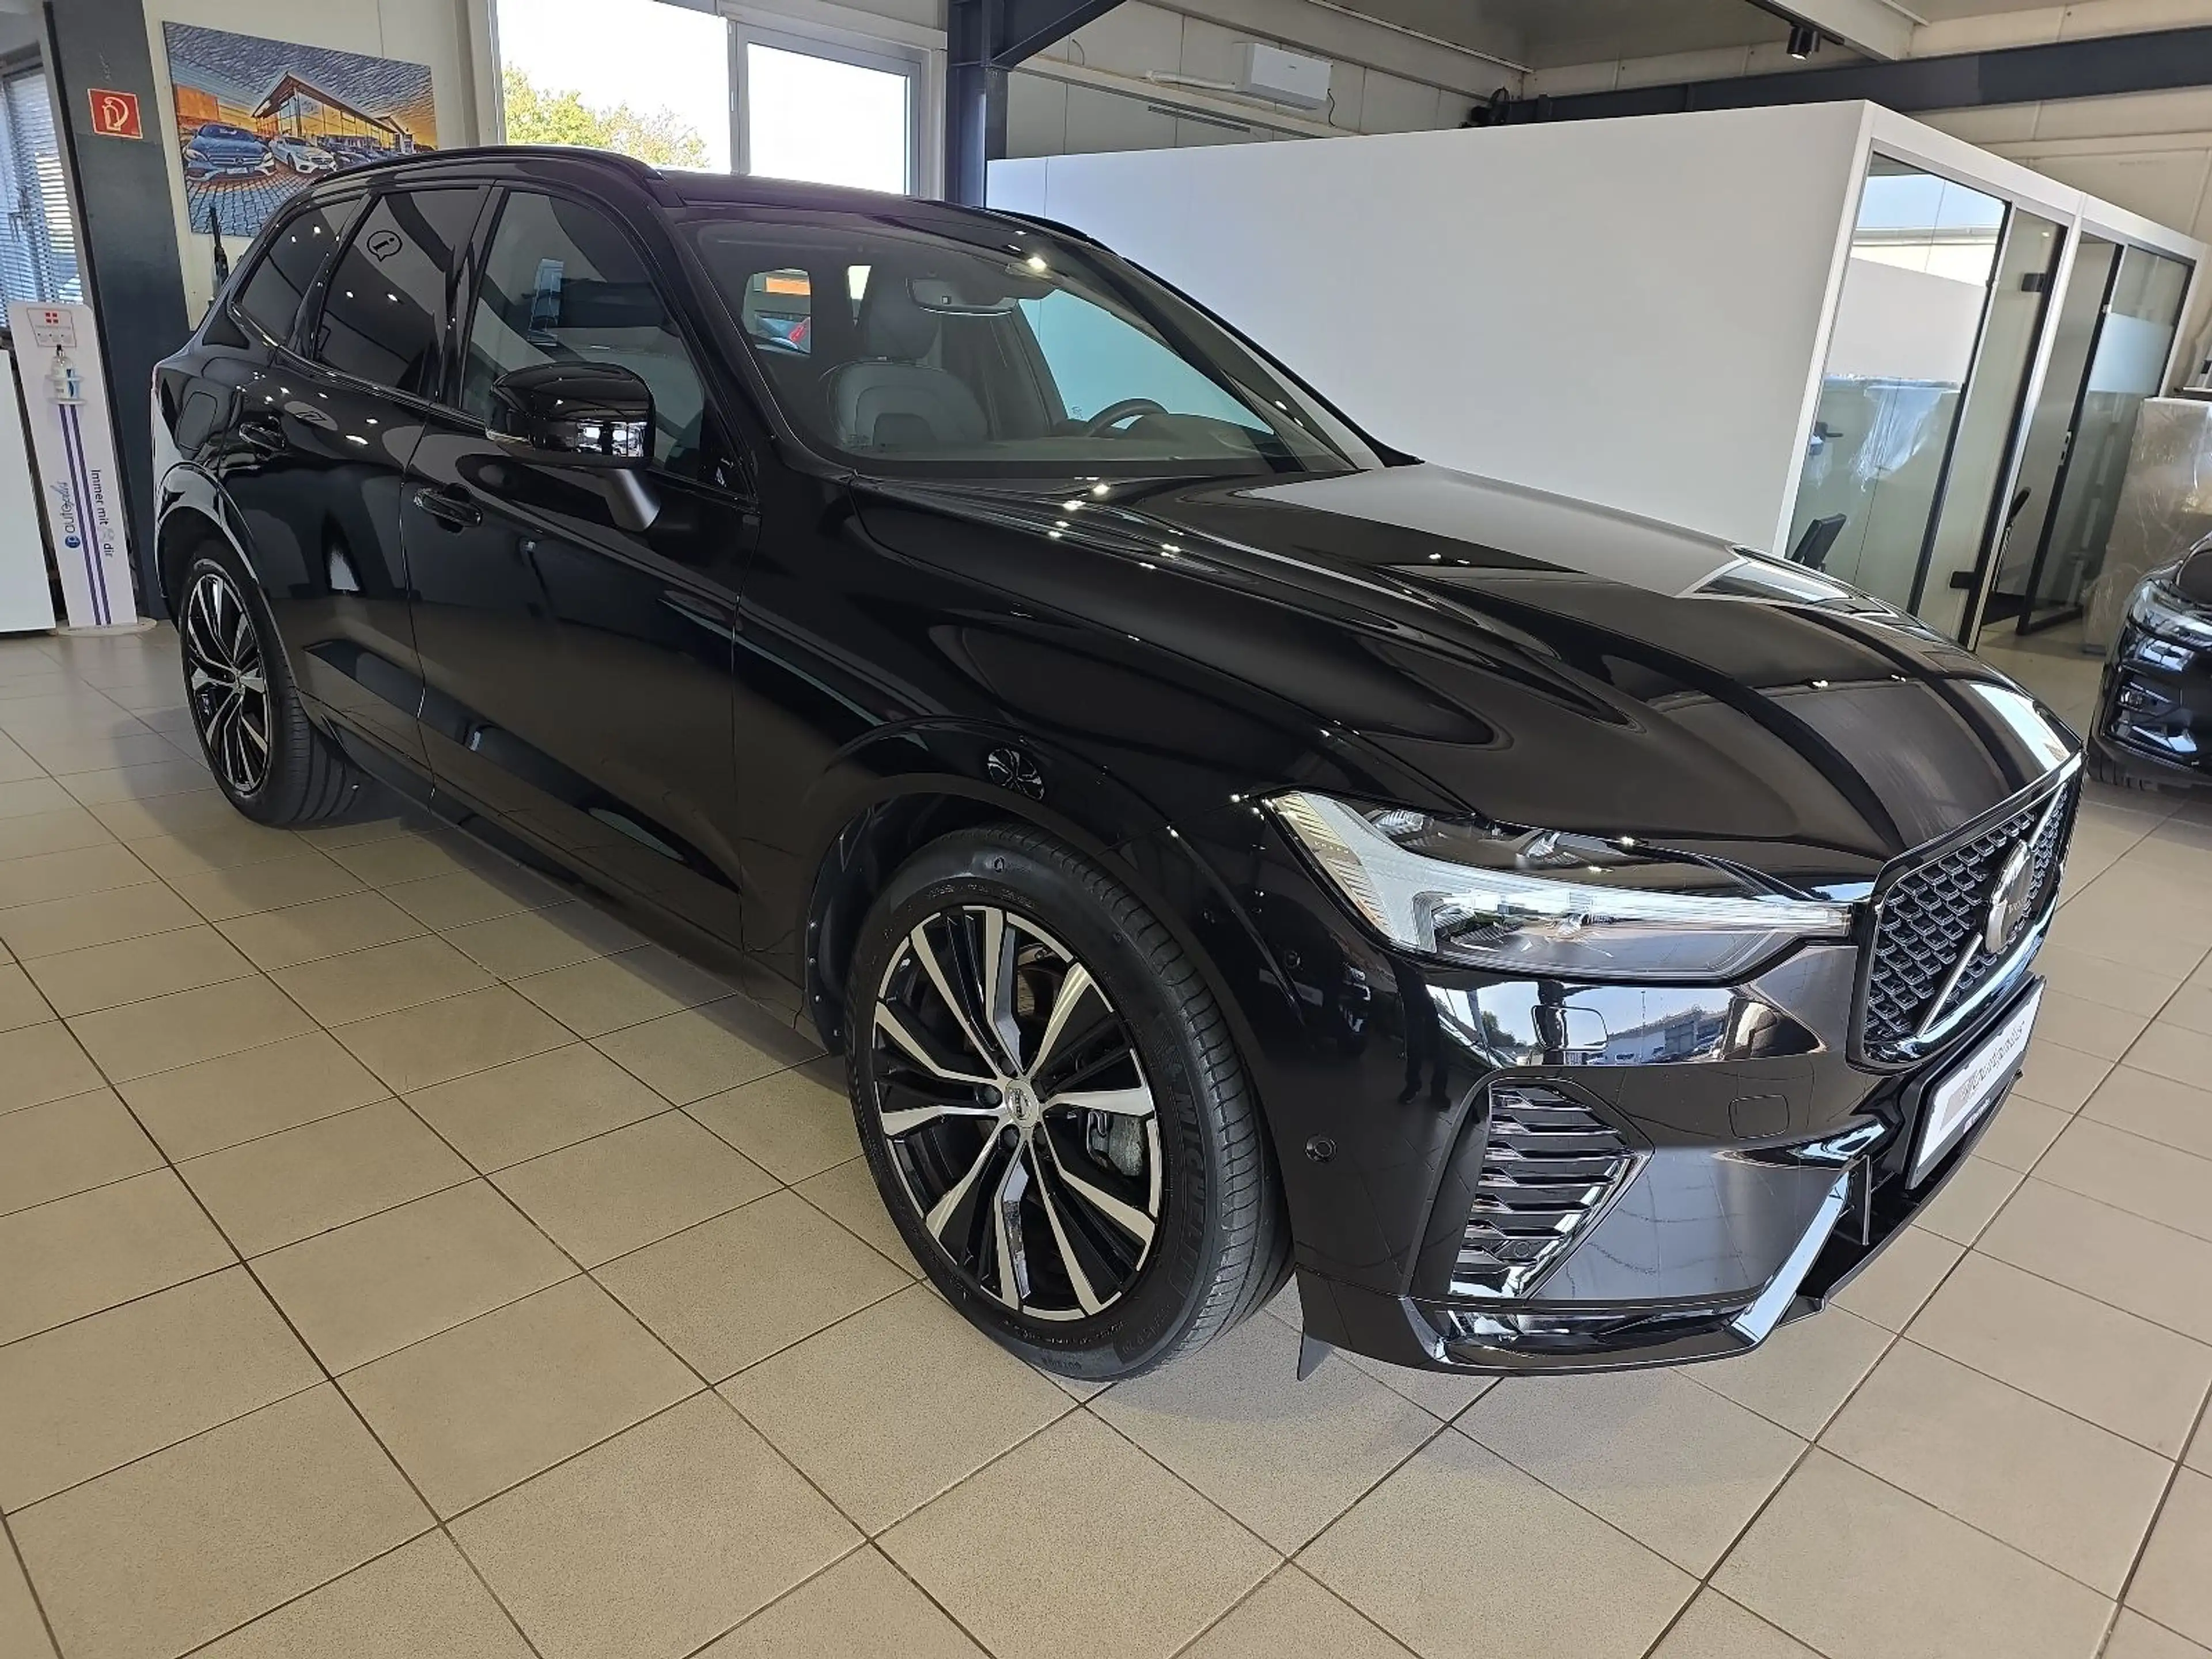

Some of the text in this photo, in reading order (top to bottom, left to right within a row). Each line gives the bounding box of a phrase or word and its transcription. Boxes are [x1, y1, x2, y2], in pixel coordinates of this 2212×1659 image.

[91, 469, 114, 558] Immer mit dir
